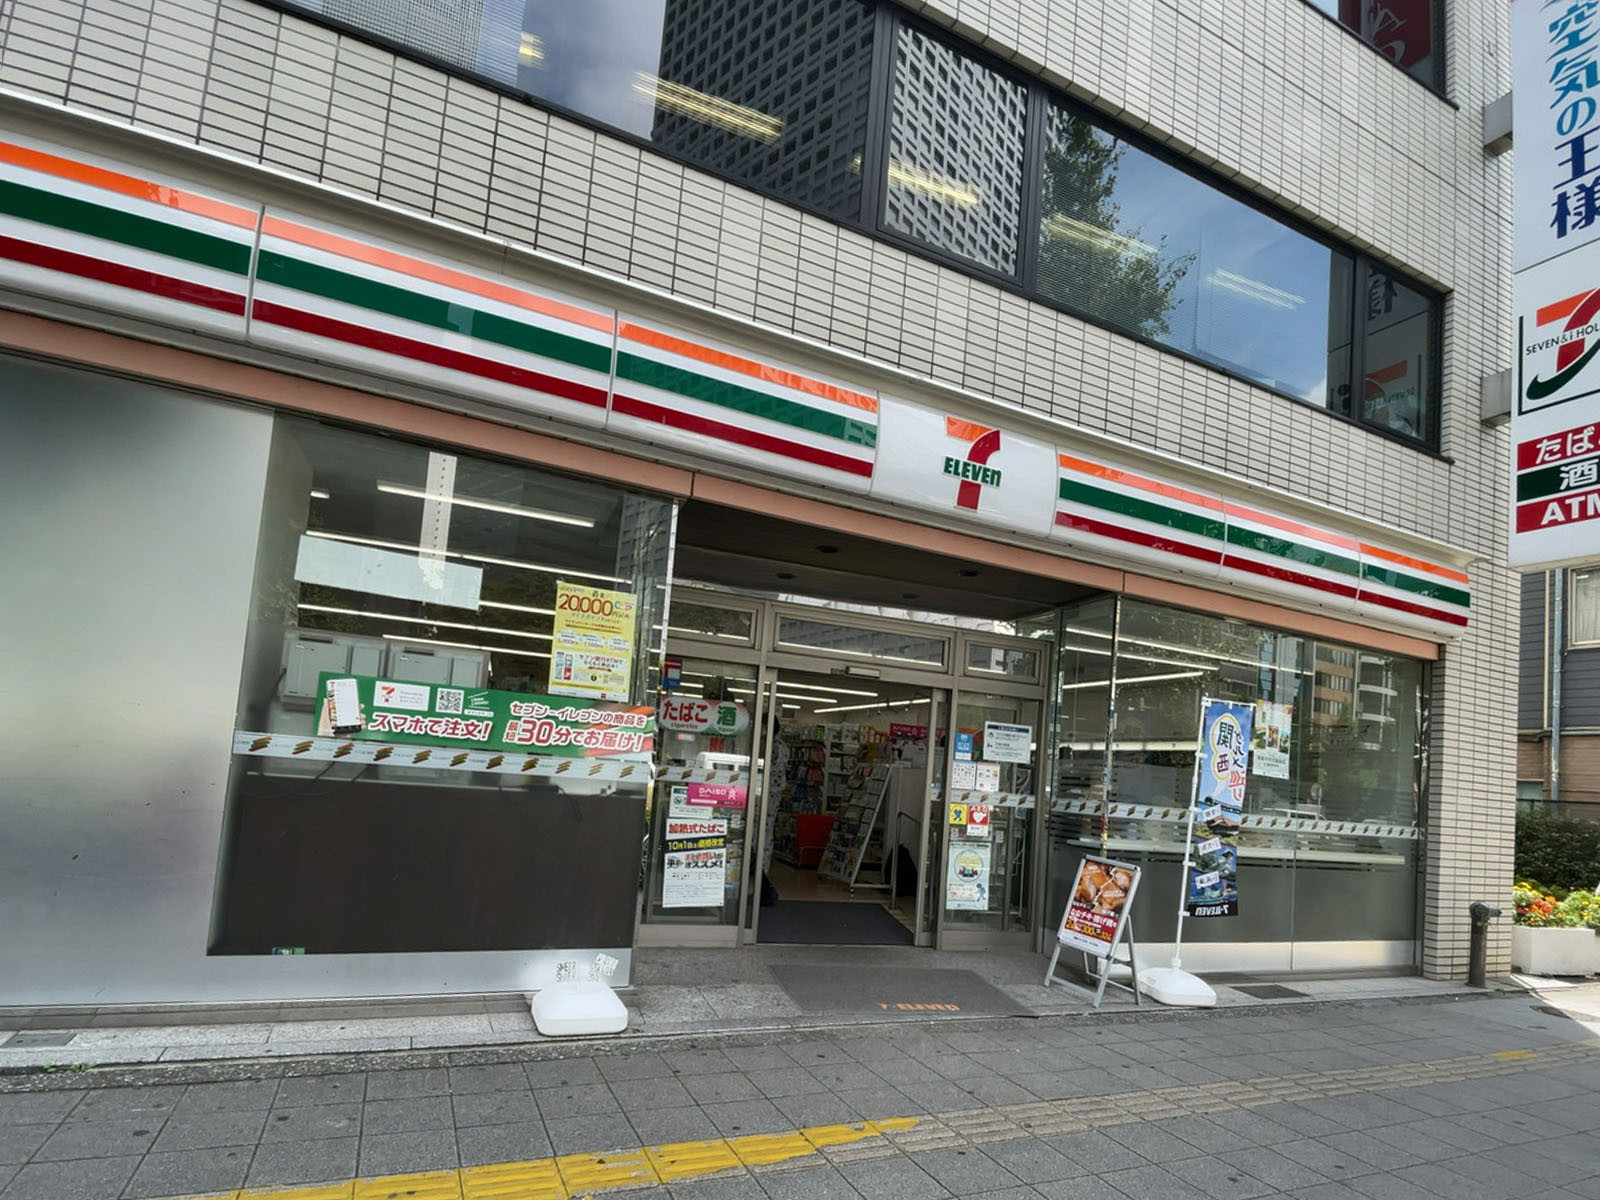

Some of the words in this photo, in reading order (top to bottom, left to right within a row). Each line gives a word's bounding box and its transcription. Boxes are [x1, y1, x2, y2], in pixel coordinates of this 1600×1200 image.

[1539, 0, 1600, 239] 空気の王様
[1536, 425, 1600, 464] たば
[1559, 458, 1600, 491] 酒
[369, 713, 493, 740] スマホで注文!
[662, 701, 708, 724] たばこ
[716, 705, 737, 727] 酒
